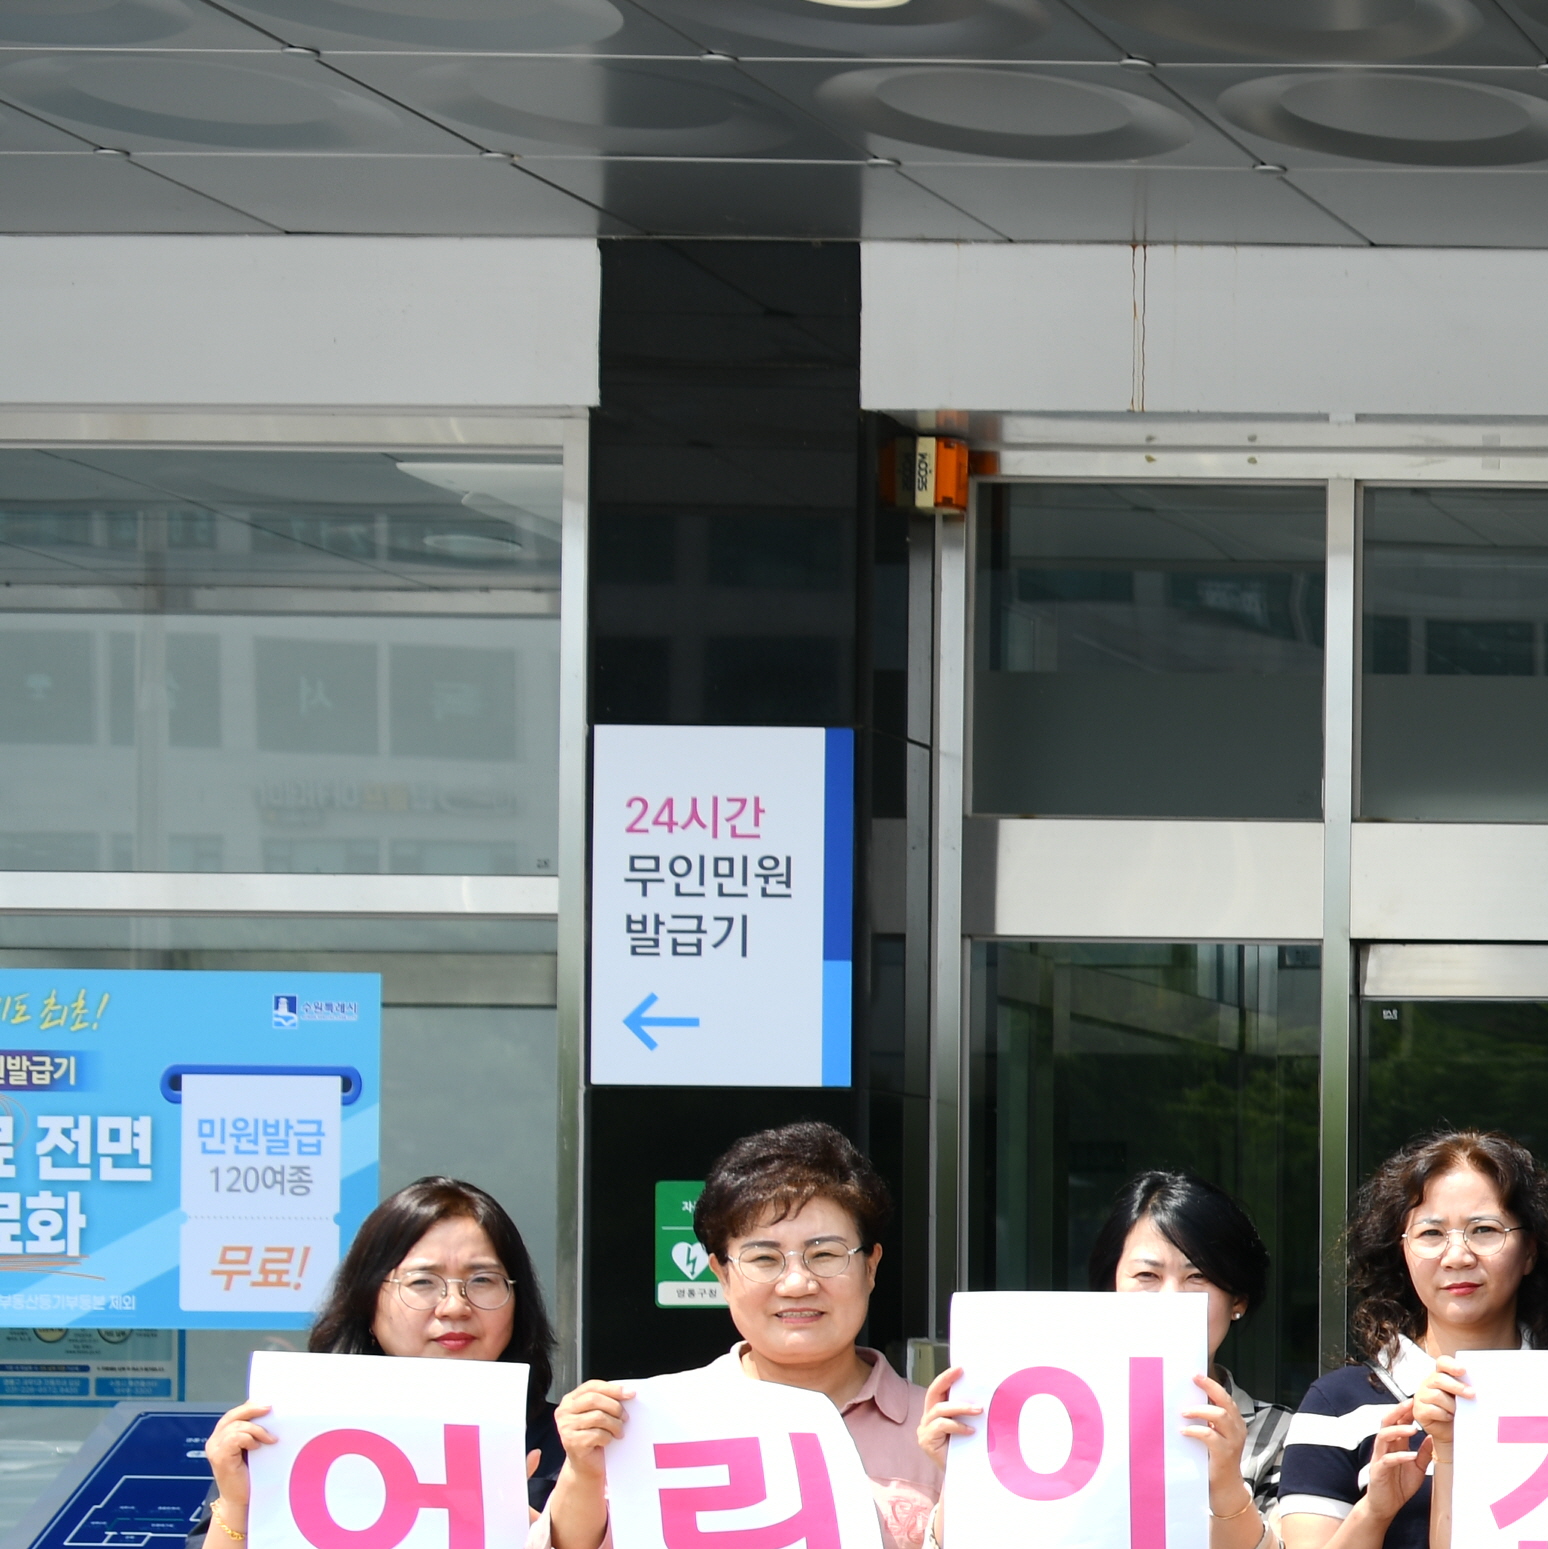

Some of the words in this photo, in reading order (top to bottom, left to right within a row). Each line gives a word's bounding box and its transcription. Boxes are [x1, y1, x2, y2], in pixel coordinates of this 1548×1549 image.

[625, 795, 765, 840] 24시간
[623, 856, 793, 900] 무인민원
[625, 914, 750, 958] 발급기
[40, 988, 111, 1032] 최초!
[301, 1001, 358, 1014] 수원특례시
[36, 1115, 152, 1182] 전면
[198, 1118, 326, 1156] 민원발급
[210, 1165, 313, 1197] 120여종
[210, 1245, 312, 1291] 무료!
[109, 1294, 136, 1311] 제외
